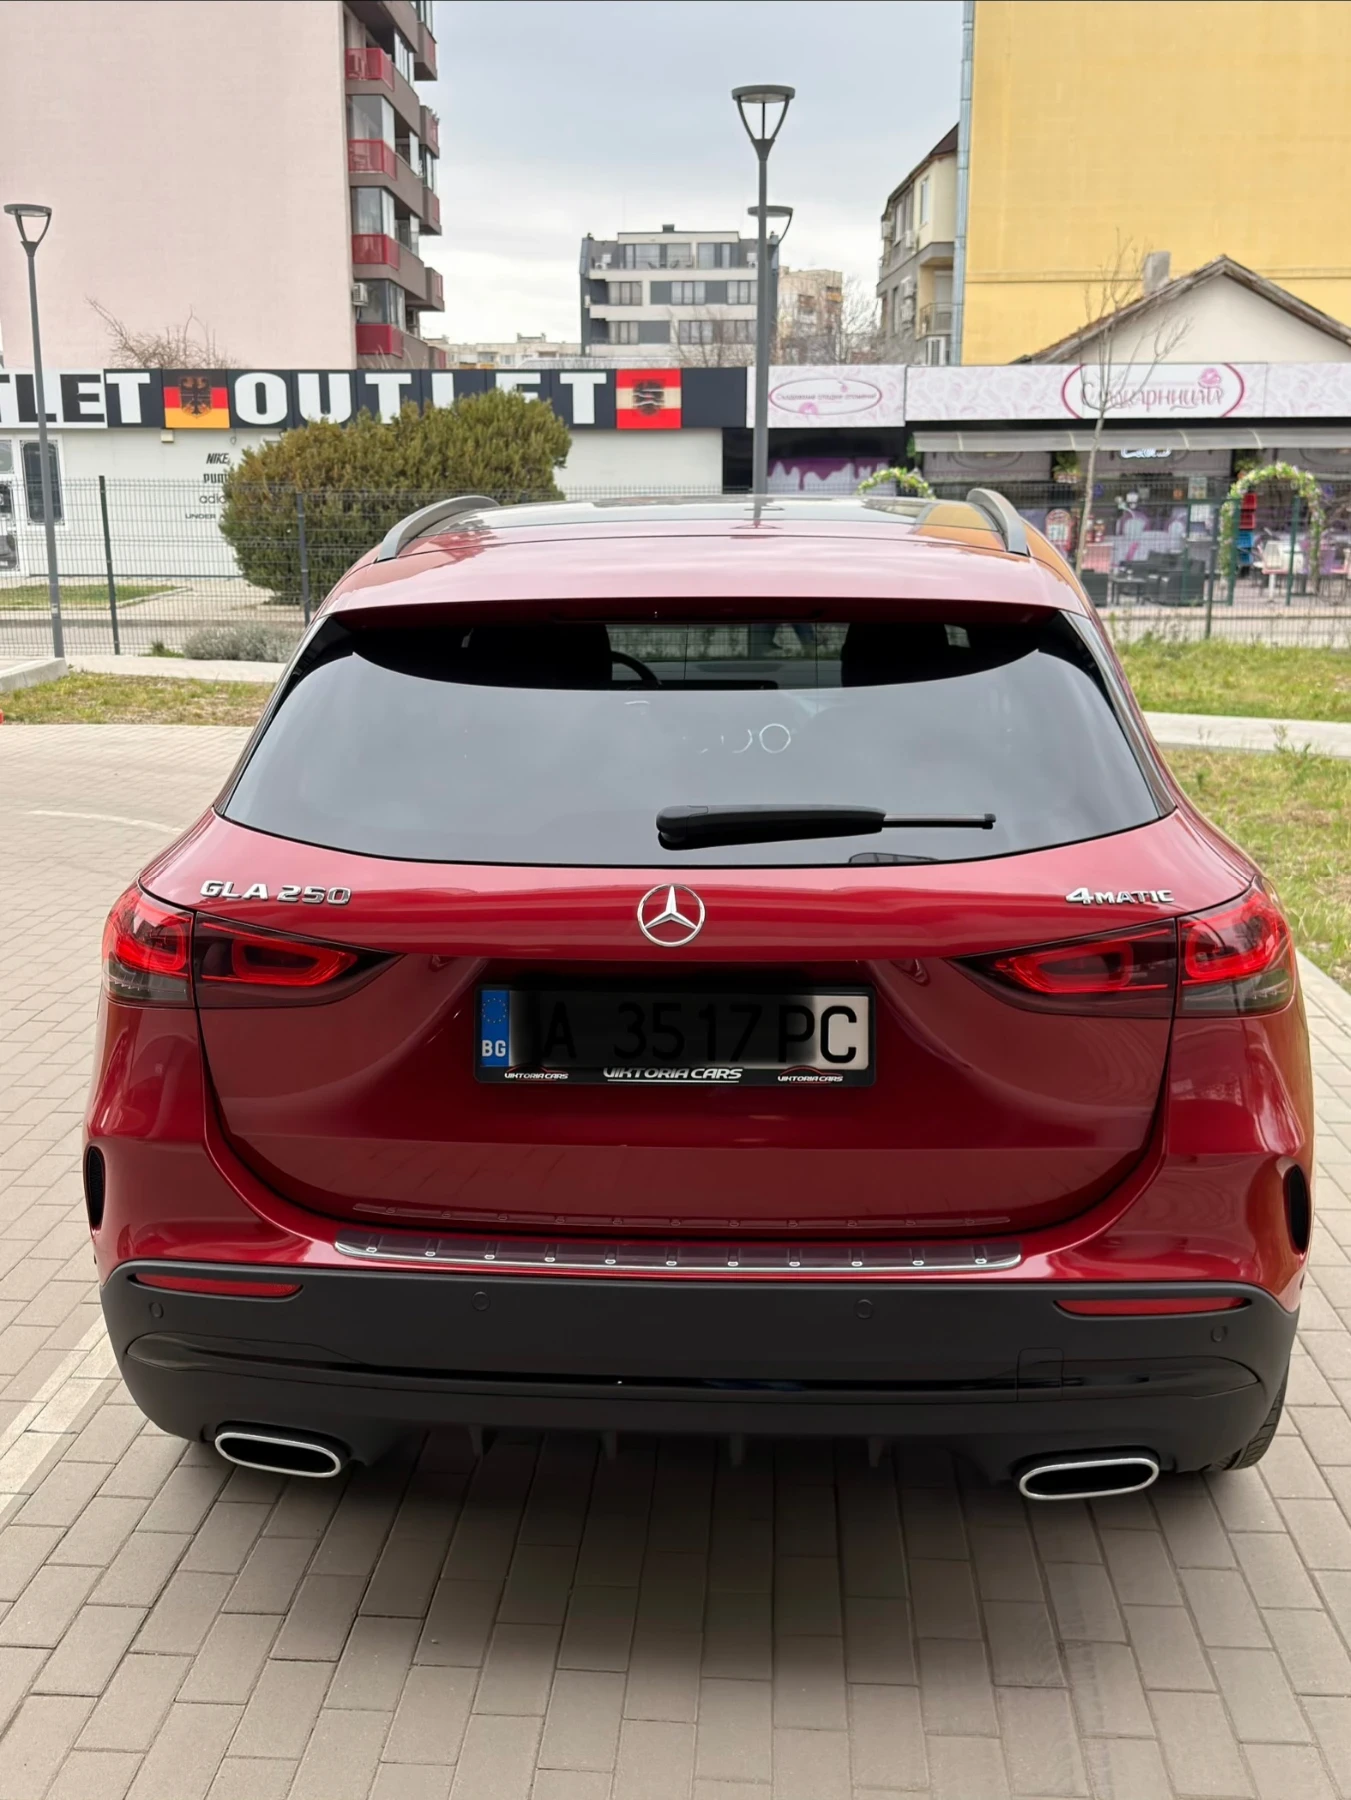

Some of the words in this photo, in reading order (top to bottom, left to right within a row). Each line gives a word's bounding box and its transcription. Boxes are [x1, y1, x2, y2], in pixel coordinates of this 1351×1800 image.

[0, 372, 150, 423] LET
[206, 453, 229, 464] NIKE
[203, 473, 228, 484] PUM
[200, 879, 269, 900] GLA
[276, 884, 351, 905] 250
[1065, 887, 1175, 905] 4MATIC
[778, 1005, 857, 1064] PC
[482, 1040, 506, 1057] BG
[691, 1068, 743, 1079] CARS
